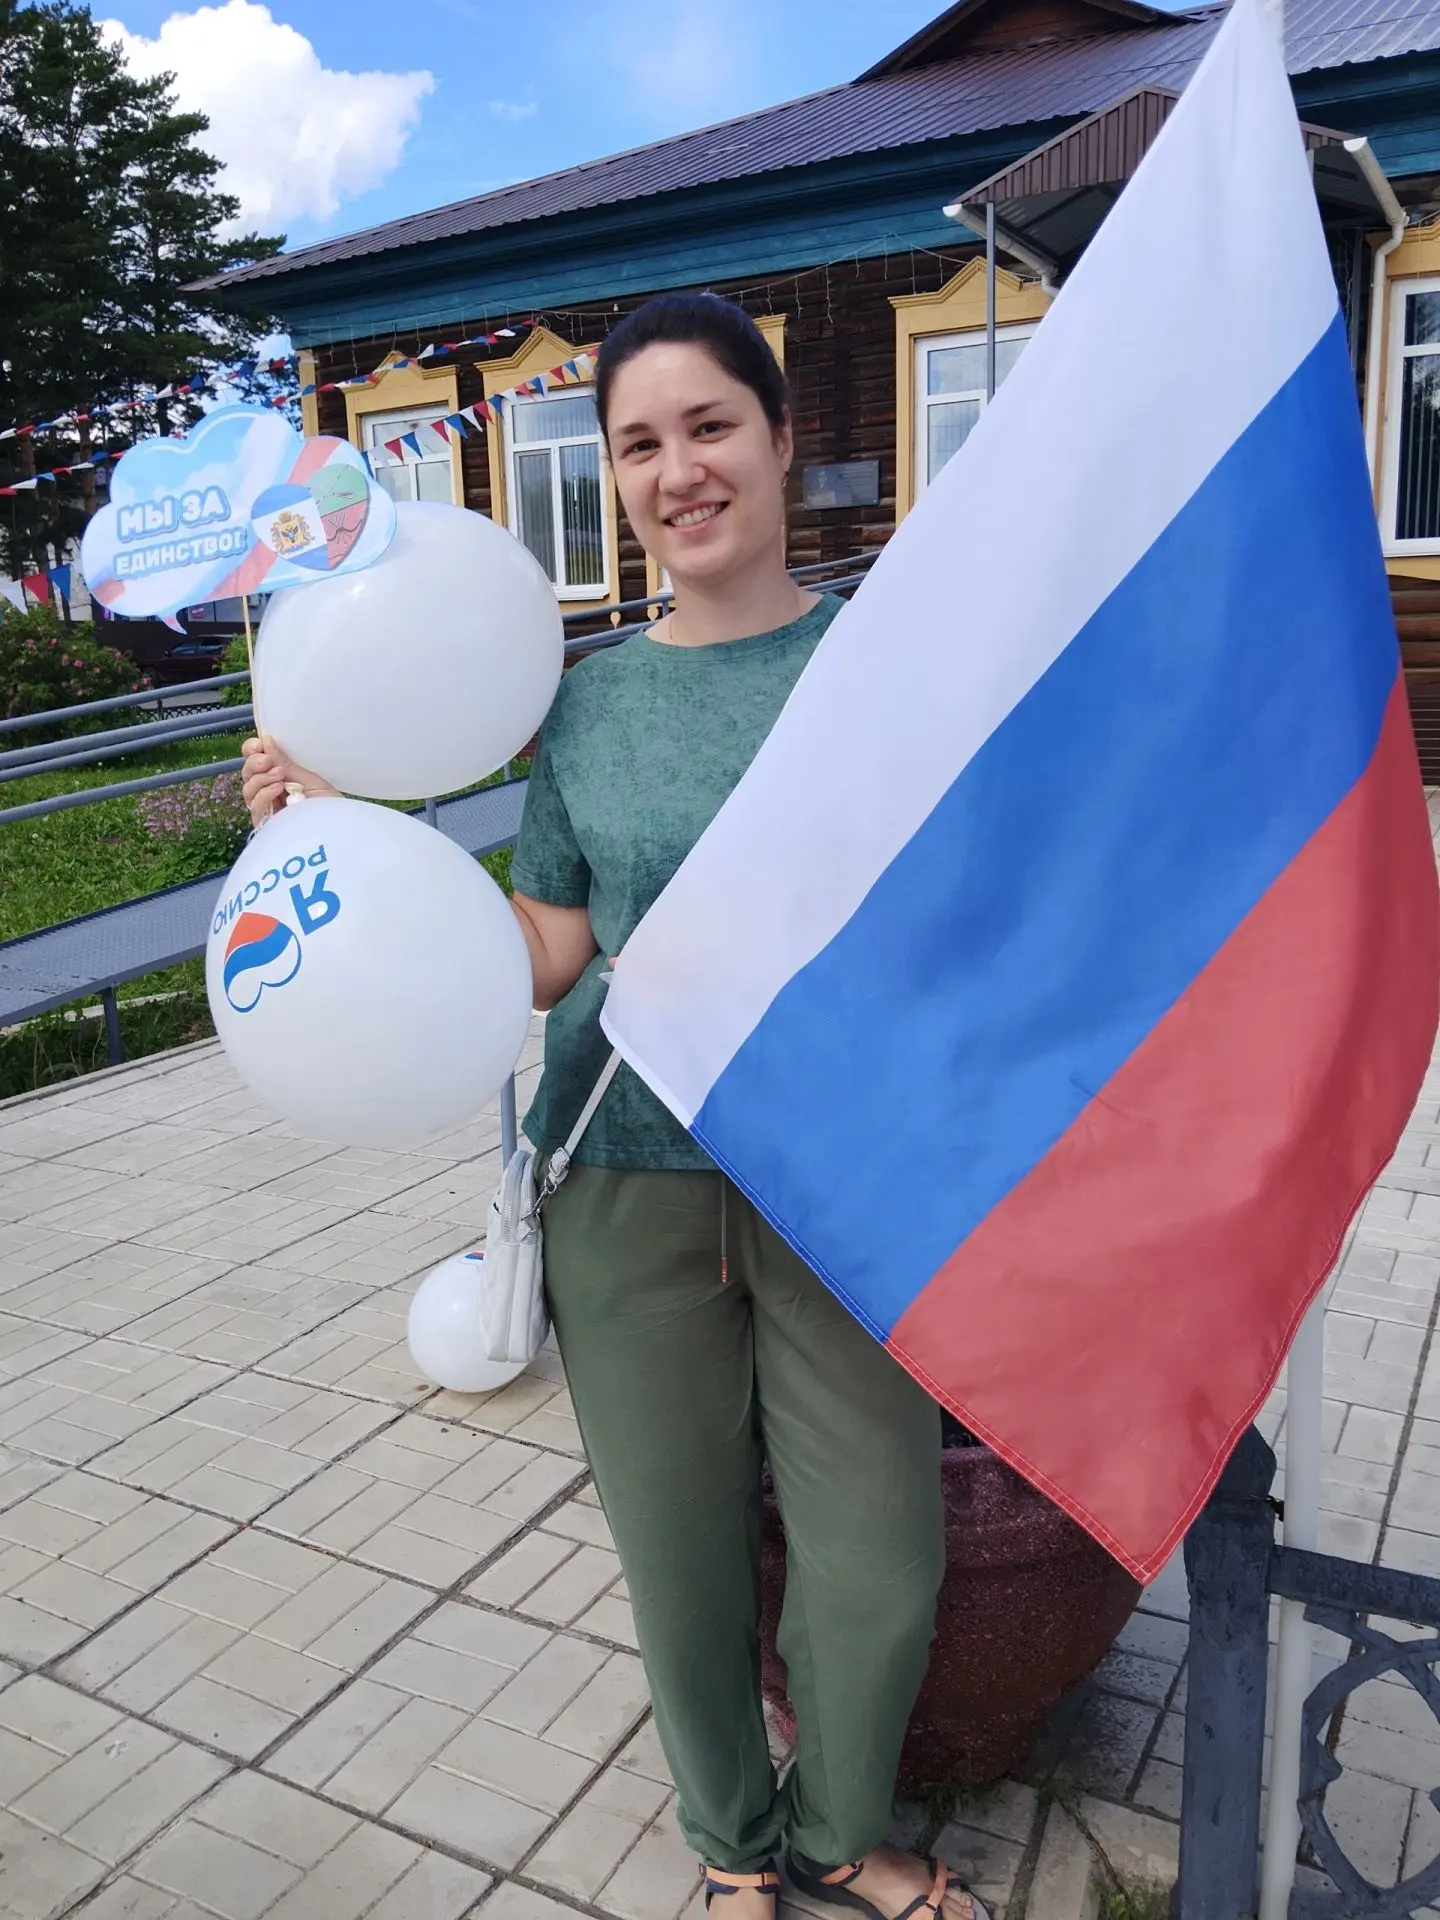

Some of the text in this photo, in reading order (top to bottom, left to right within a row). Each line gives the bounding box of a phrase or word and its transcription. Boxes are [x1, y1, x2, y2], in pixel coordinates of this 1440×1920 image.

[119, 488, 225, 540] МЫ ЗА
[115, 530, 243, 577] ЕДИНСТВО!
[213, 844, 328, 935] РОССИЮ
[289, 869, 341, 936] Я
